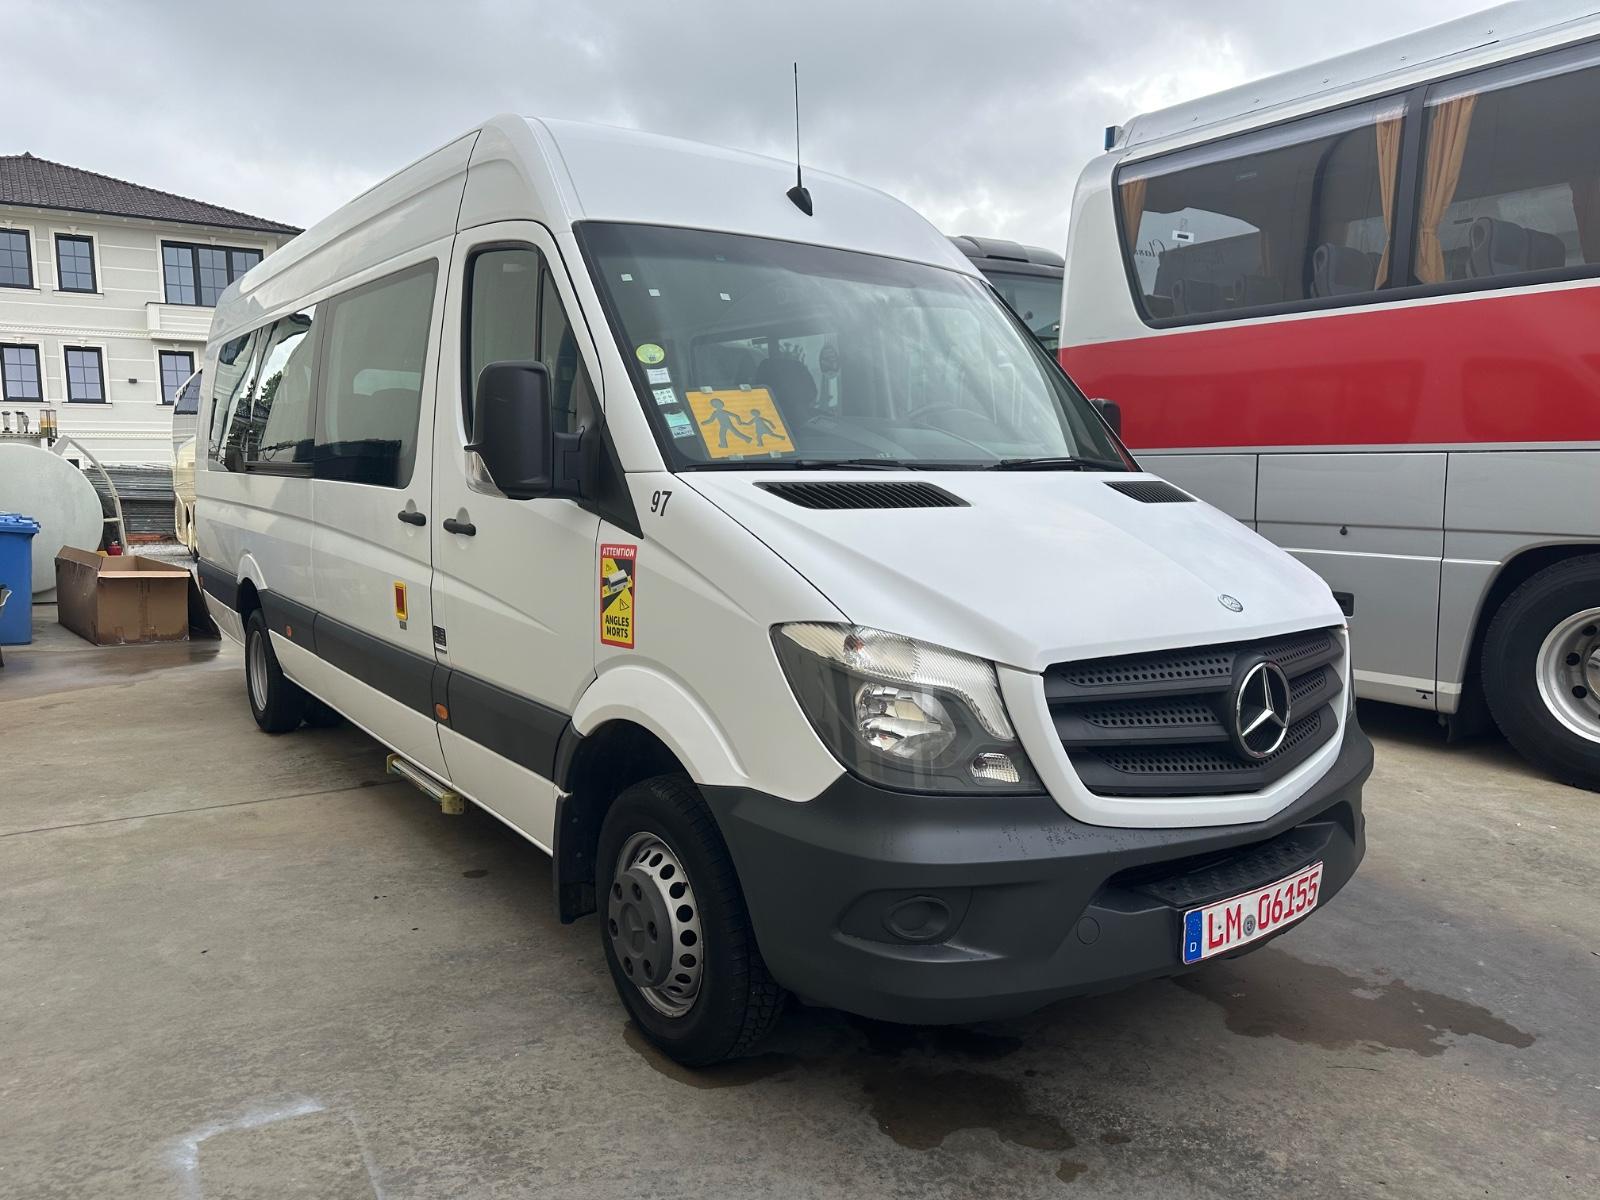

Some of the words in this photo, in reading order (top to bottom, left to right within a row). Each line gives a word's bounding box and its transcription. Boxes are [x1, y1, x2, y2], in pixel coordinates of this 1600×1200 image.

[651, 490, 672, 516] 97
[602, 547, 635, 557] ATTENTION
[605, 615, 630, 627] ANGLES
[1208, 903, 1242, 949] LM
[1258, 871, 1319, 930] 06155
[1189, 941, 1197, 952] D
